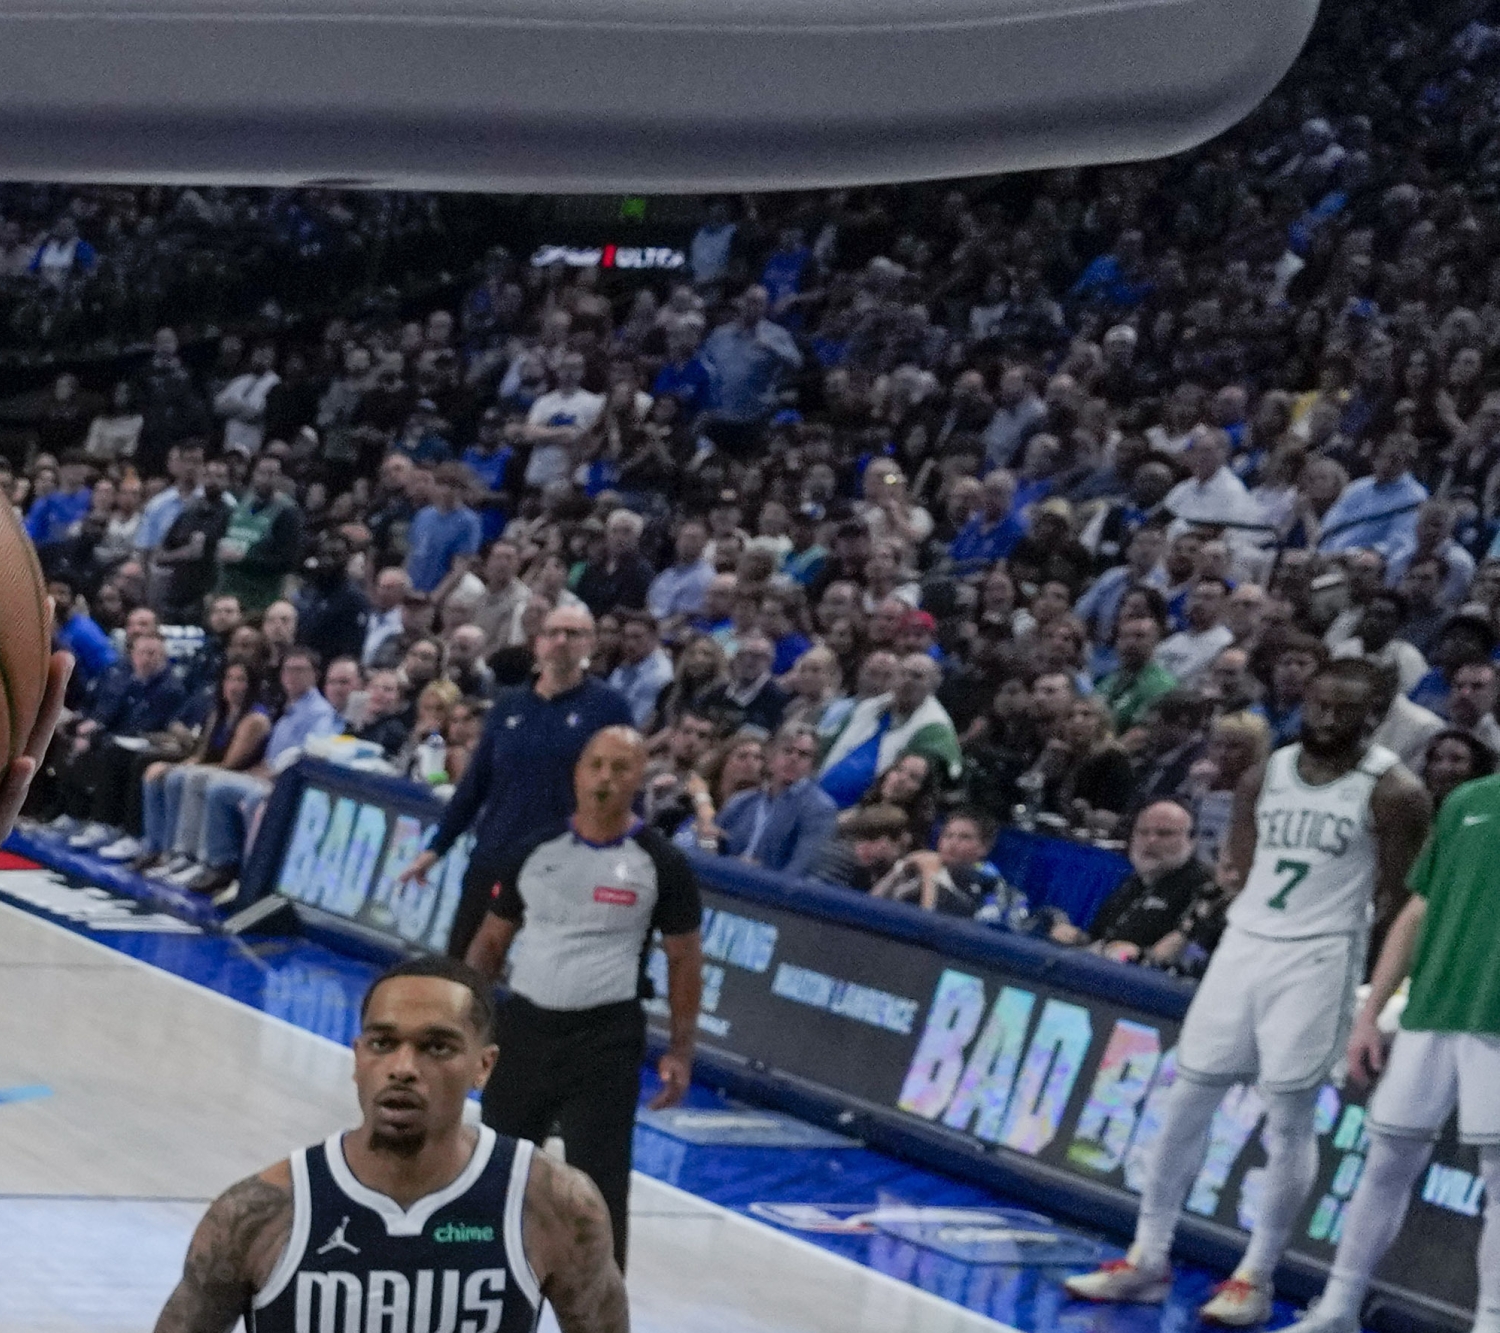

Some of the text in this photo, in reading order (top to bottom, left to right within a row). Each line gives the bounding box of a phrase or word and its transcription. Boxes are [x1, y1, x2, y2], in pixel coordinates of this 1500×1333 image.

[279, 788, 386, 917] BAD
[1268, 859, 1311, 908] 7
[898, 968, 1092, 1156] BAD
[433, 1223, 495, 1243] chime
